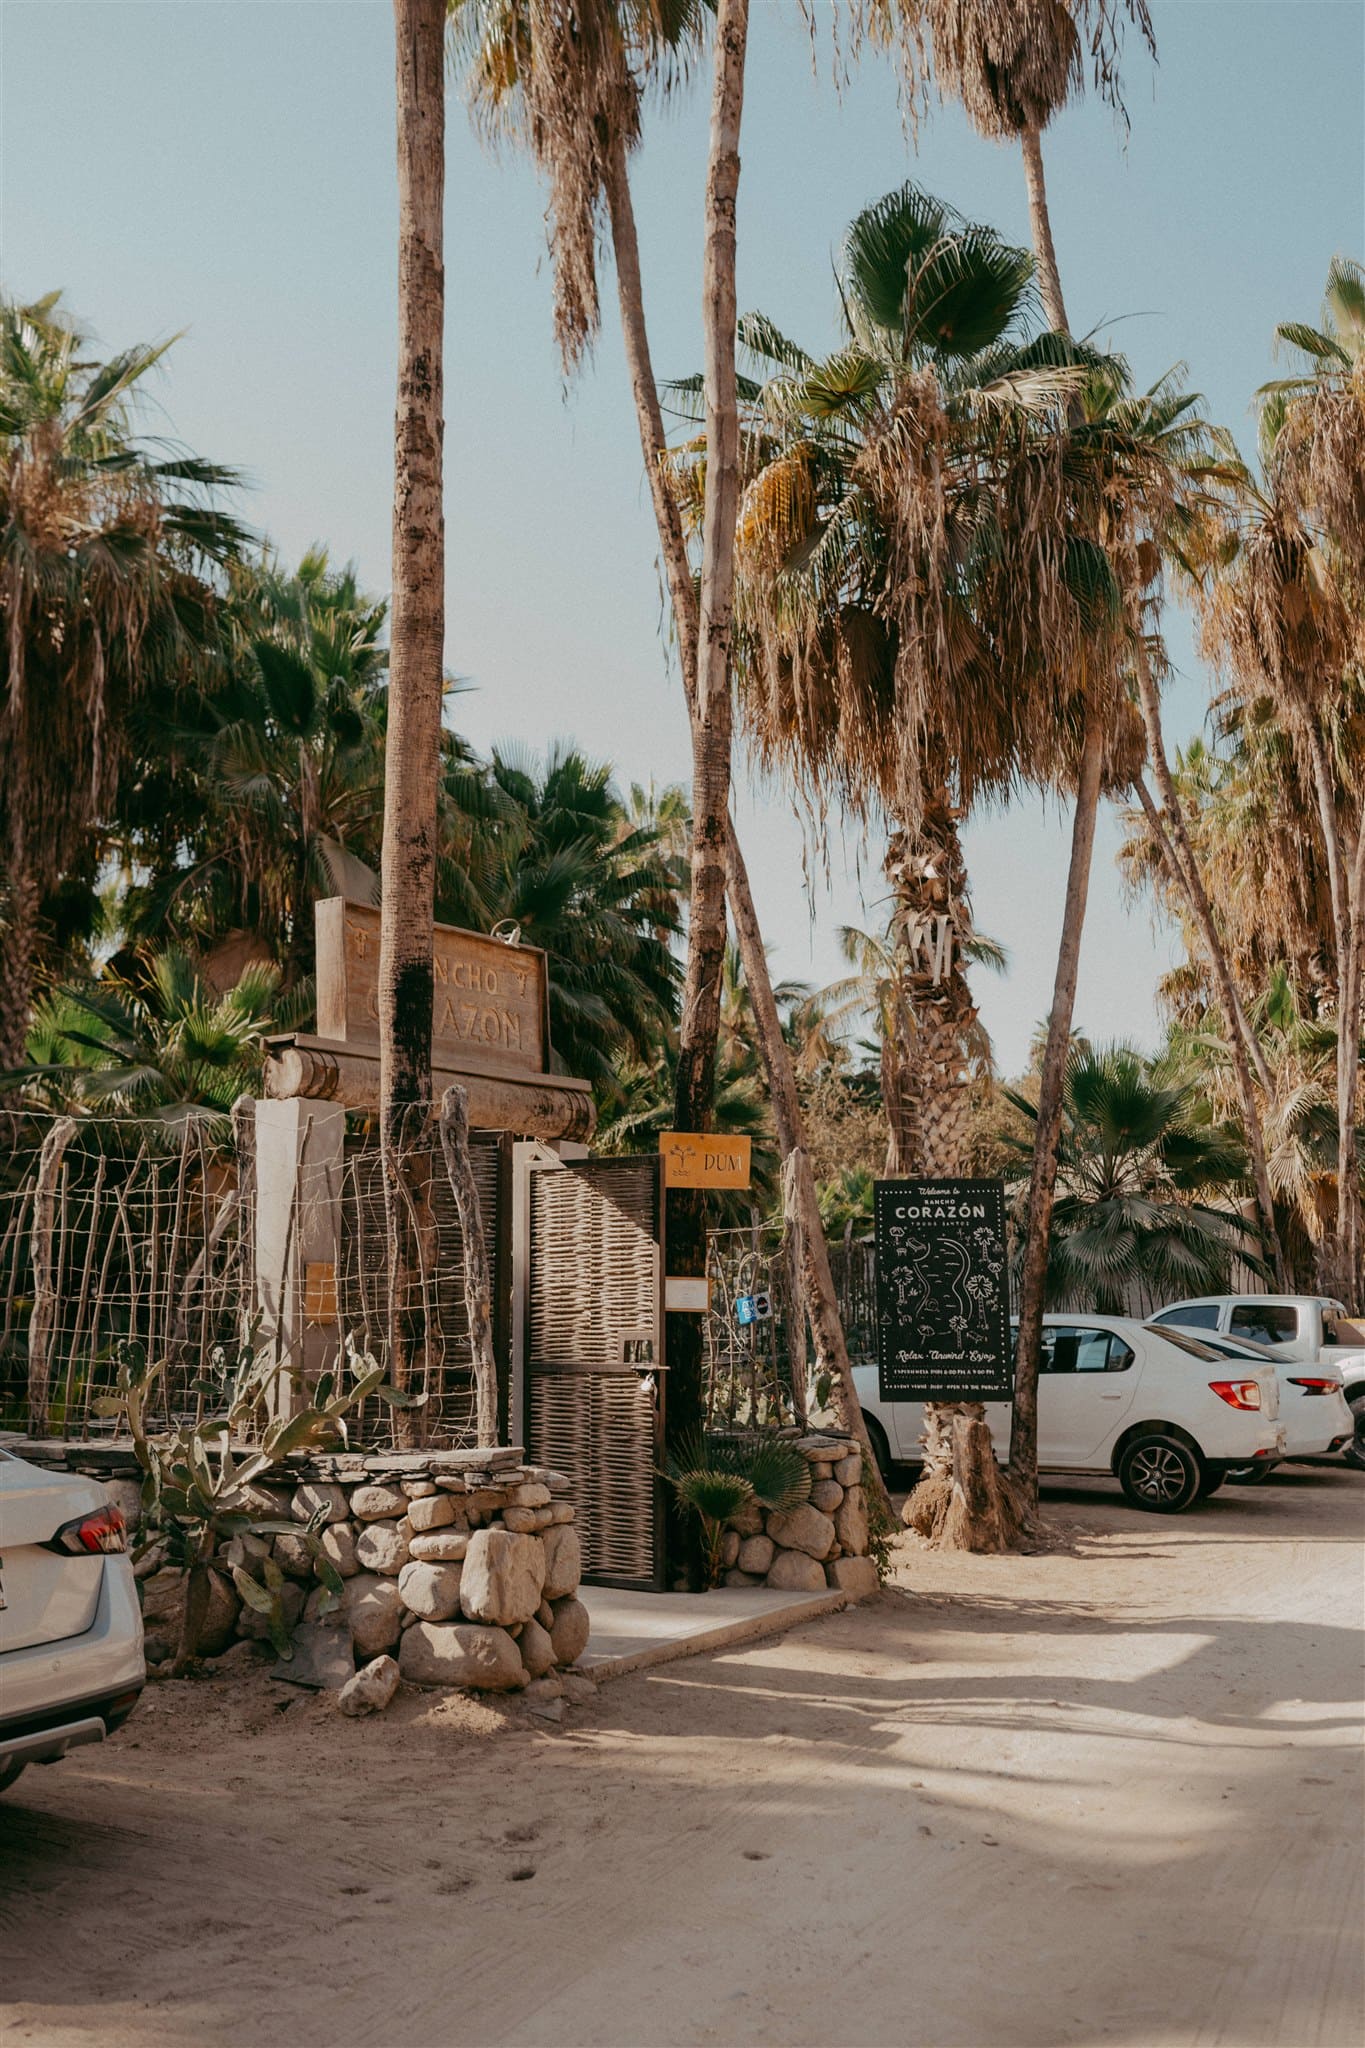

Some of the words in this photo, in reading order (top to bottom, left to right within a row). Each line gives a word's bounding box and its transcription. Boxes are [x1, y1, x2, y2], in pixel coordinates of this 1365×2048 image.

[433, 954, 498, 996] NCHO
[917, 1187, 951, 1196] Welcome
[953, 1187, 961, 1195] to
[895, 1202, 985, 1219] CORAZÓN
[895, 1349, 925, 1363] Relax
[929, 1349, 966, 1360] Unwind
[968, 1349, 996, 1363] Enjoy
